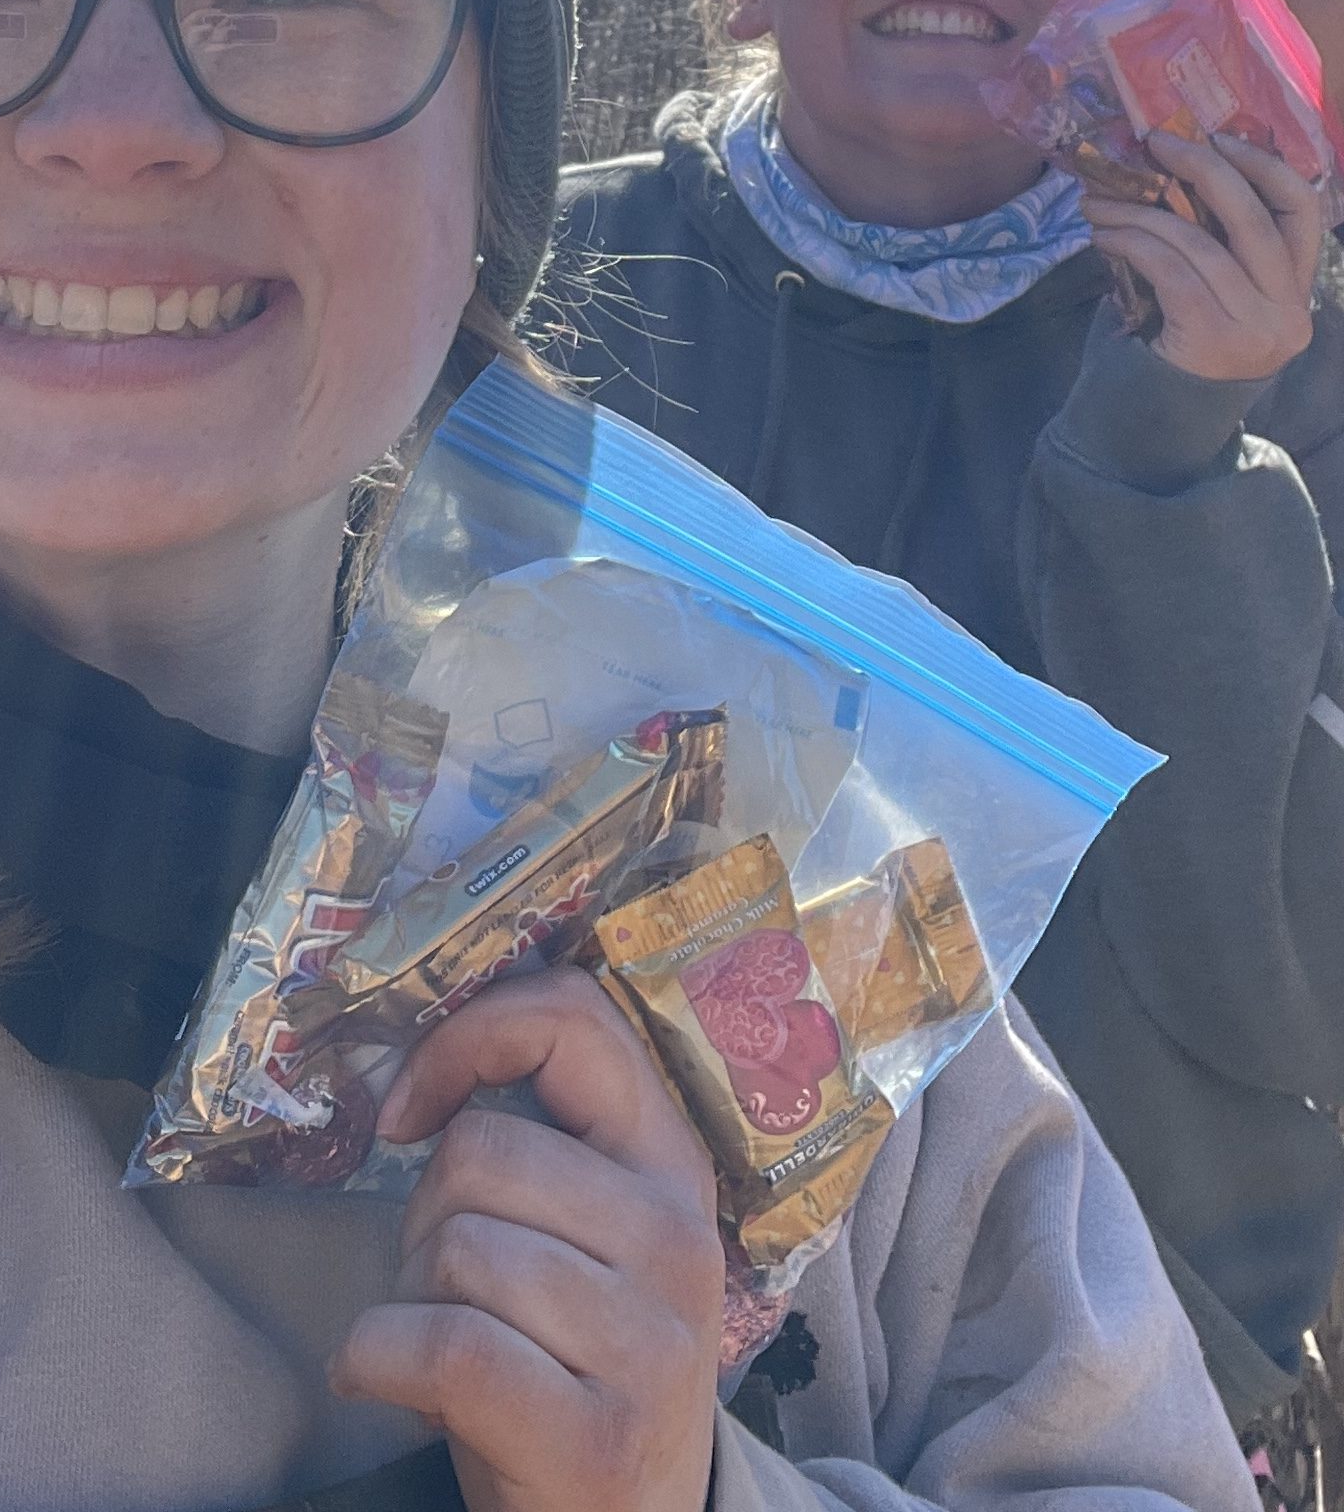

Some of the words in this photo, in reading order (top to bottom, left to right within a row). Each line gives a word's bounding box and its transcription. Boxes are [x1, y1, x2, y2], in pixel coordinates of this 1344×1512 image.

[468, 845, 528, 895] twix.com
[686, 896, 749, 939] Caramel
[745, 894, 780, 921] Milk
[668, 916, 744, 963] Chocolate
